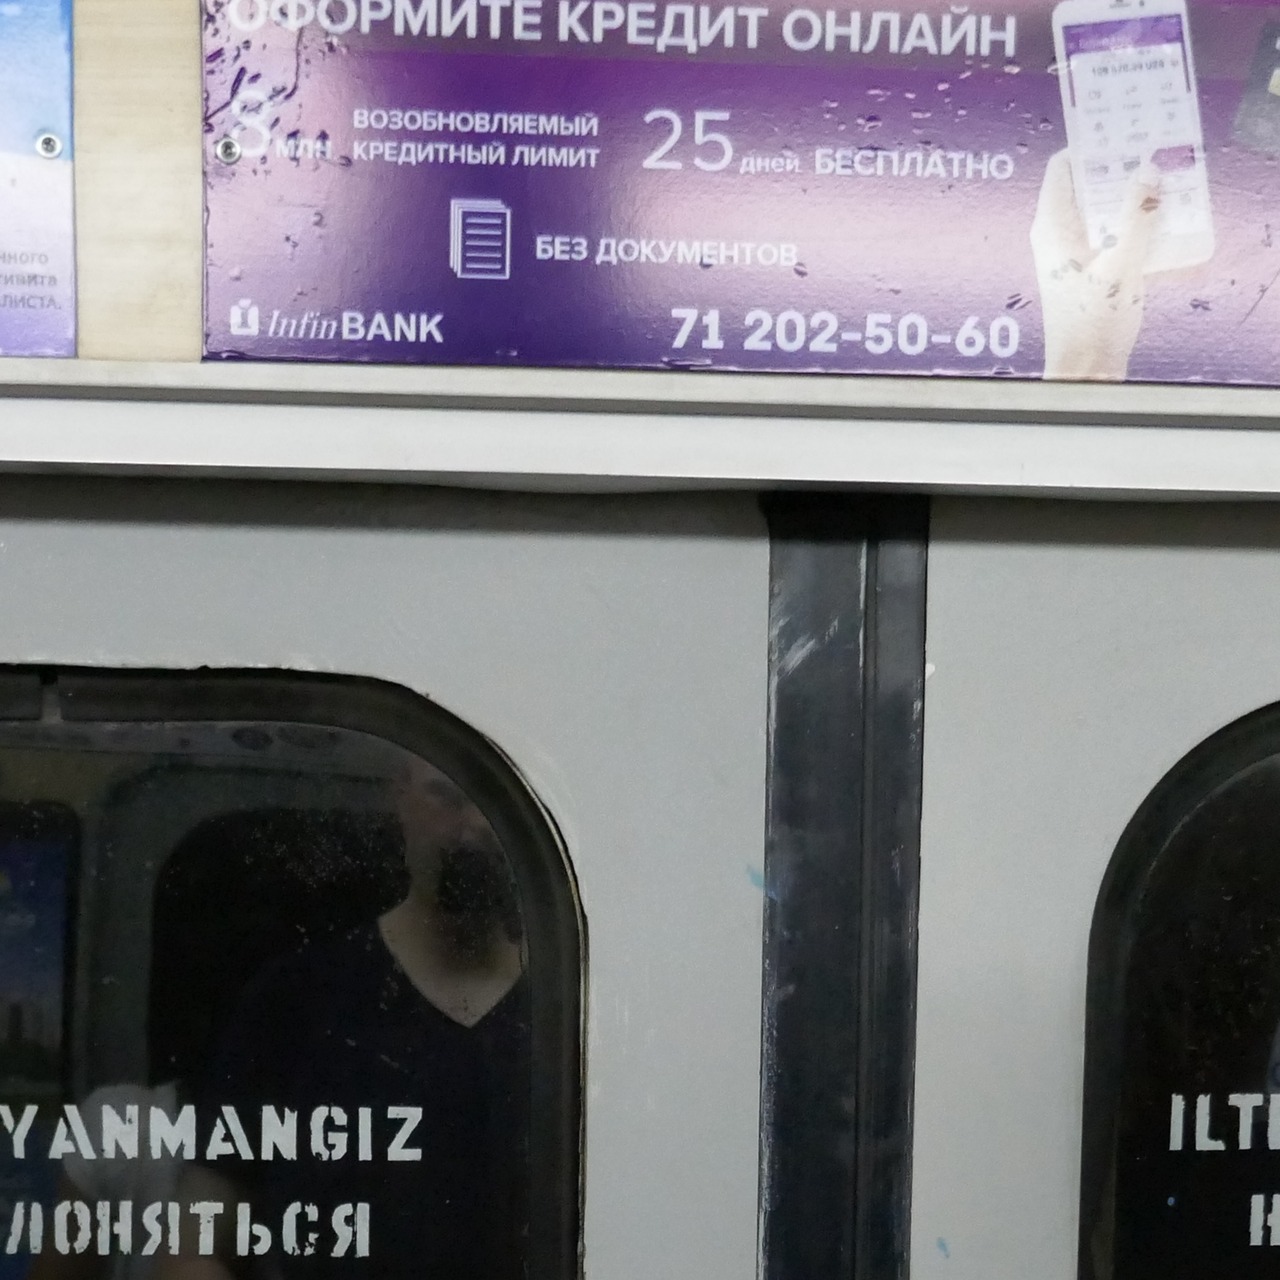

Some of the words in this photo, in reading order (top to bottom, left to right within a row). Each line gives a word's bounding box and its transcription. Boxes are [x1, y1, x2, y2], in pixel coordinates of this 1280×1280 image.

[228, 0, 542, 41] ОФОРМИТЕ
[558, 2, 769, 54] КРЕДИТ
[782, 5, 1017, 58] ОНЛАЙН
[352, 108, 600, 138] ВОЗОБНОВЛЯЕМЫЙ
[352, 140, 506, 167] КРЕДИТНЫЙ
[512, 145, 601, 168] ЛИМИТ
[642, 108, 734, 172] 25
[814, 147, 1015, 181] БЕСПЛАТНО
[535, 235, 589, 262] БЕЗ
[595, 238, 799, 269] ДОКУМЕНТОВ
[670, 307, 724, 352] 71
[743, 309, 1020, 358] 202-50-60
